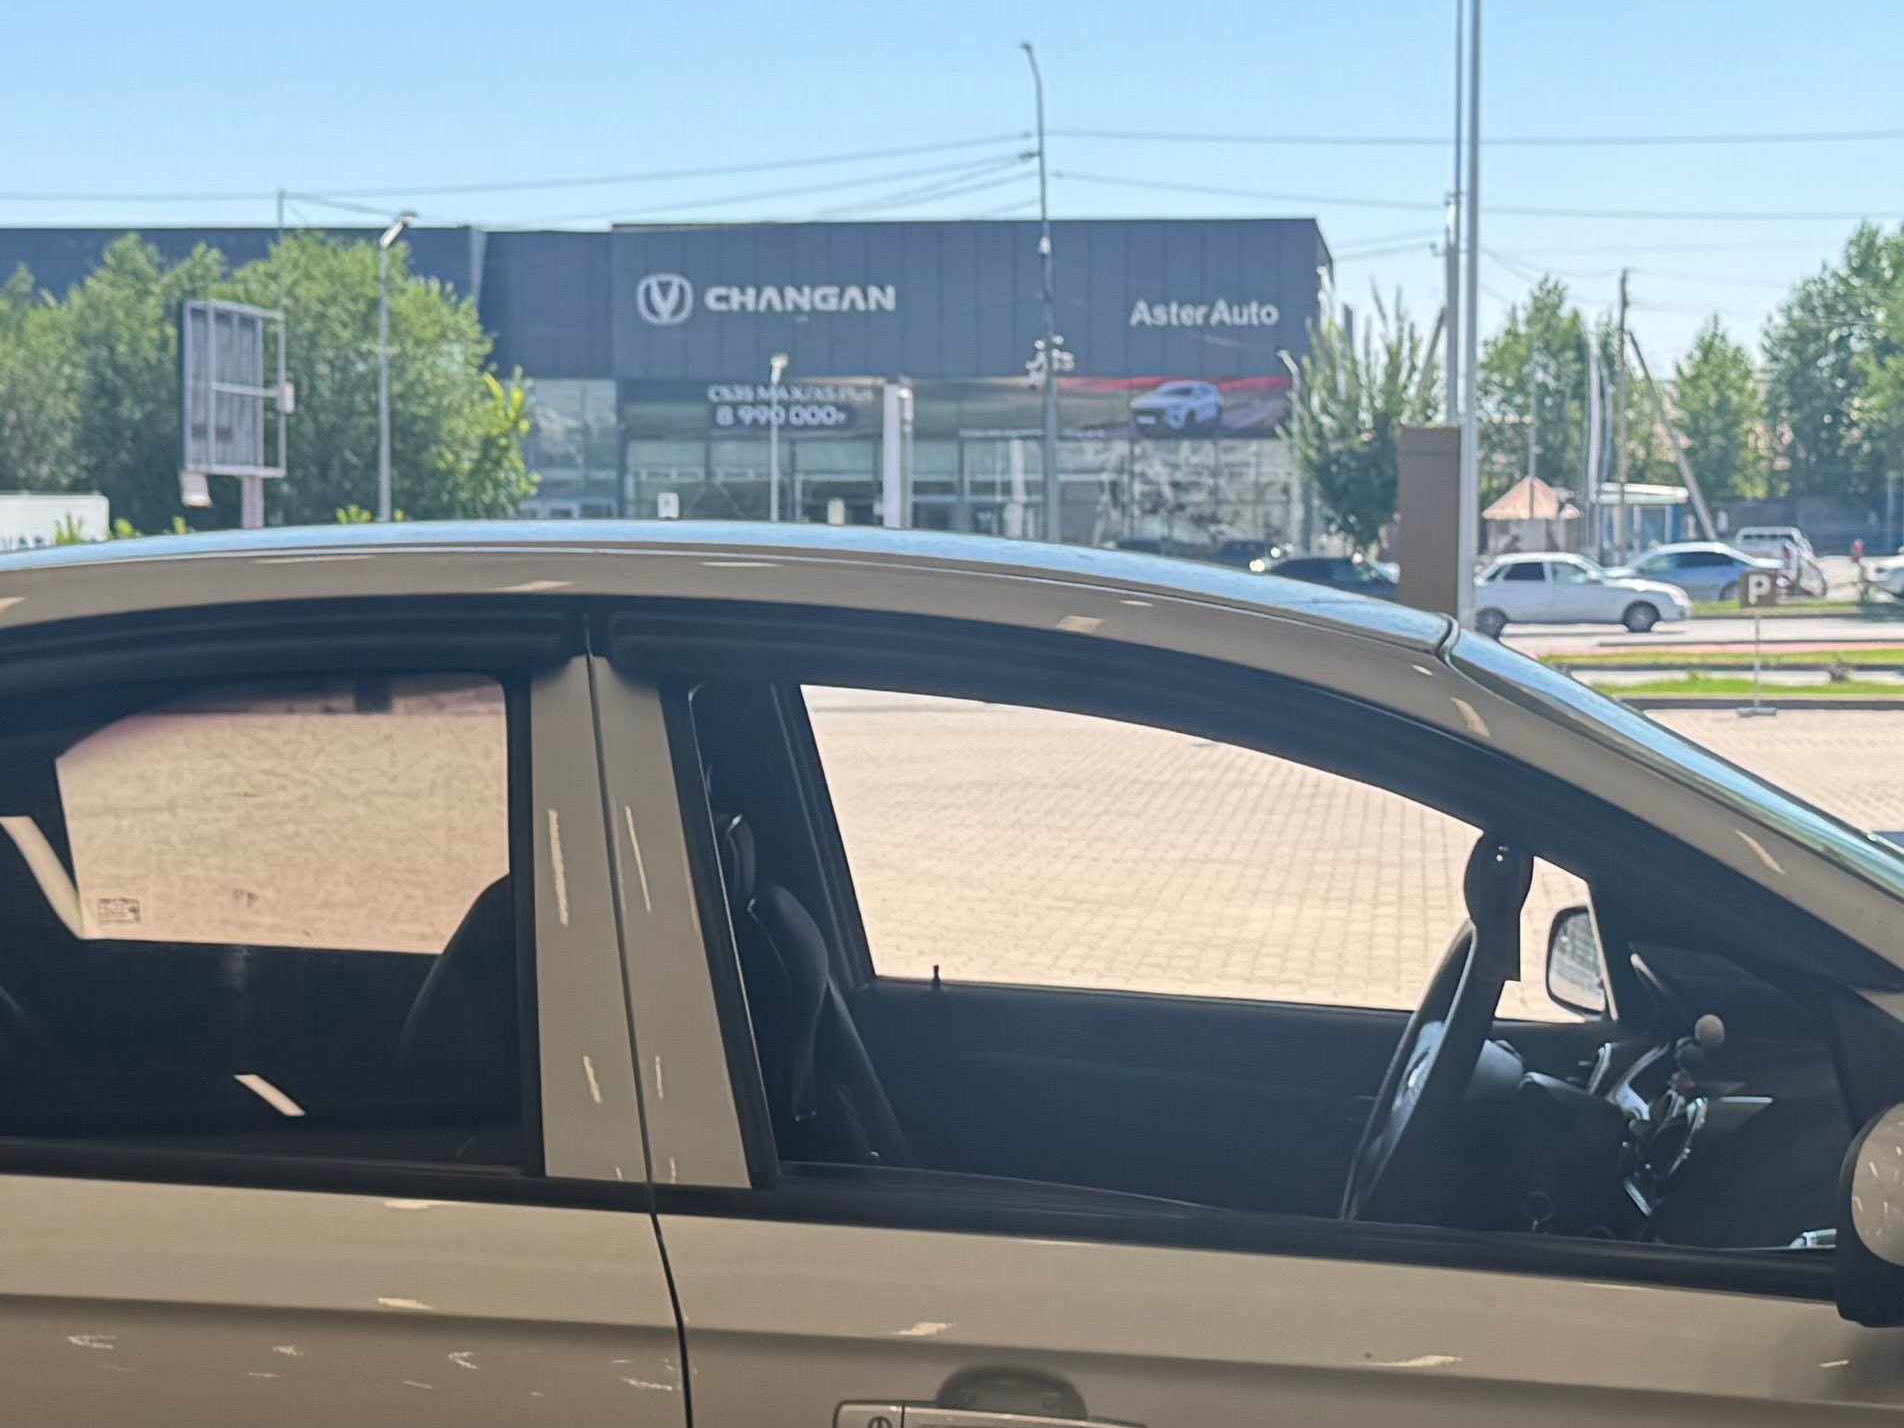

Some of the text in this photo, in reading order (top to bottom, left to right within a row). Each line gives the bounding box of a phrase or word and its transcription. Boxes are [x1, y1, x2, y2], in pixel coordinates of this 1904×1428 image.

[704, 285, 897, 312] CHANGAN
[1129, 298, 1280, 326] AsterAuto
[1748, 574, 1771, 605] P
